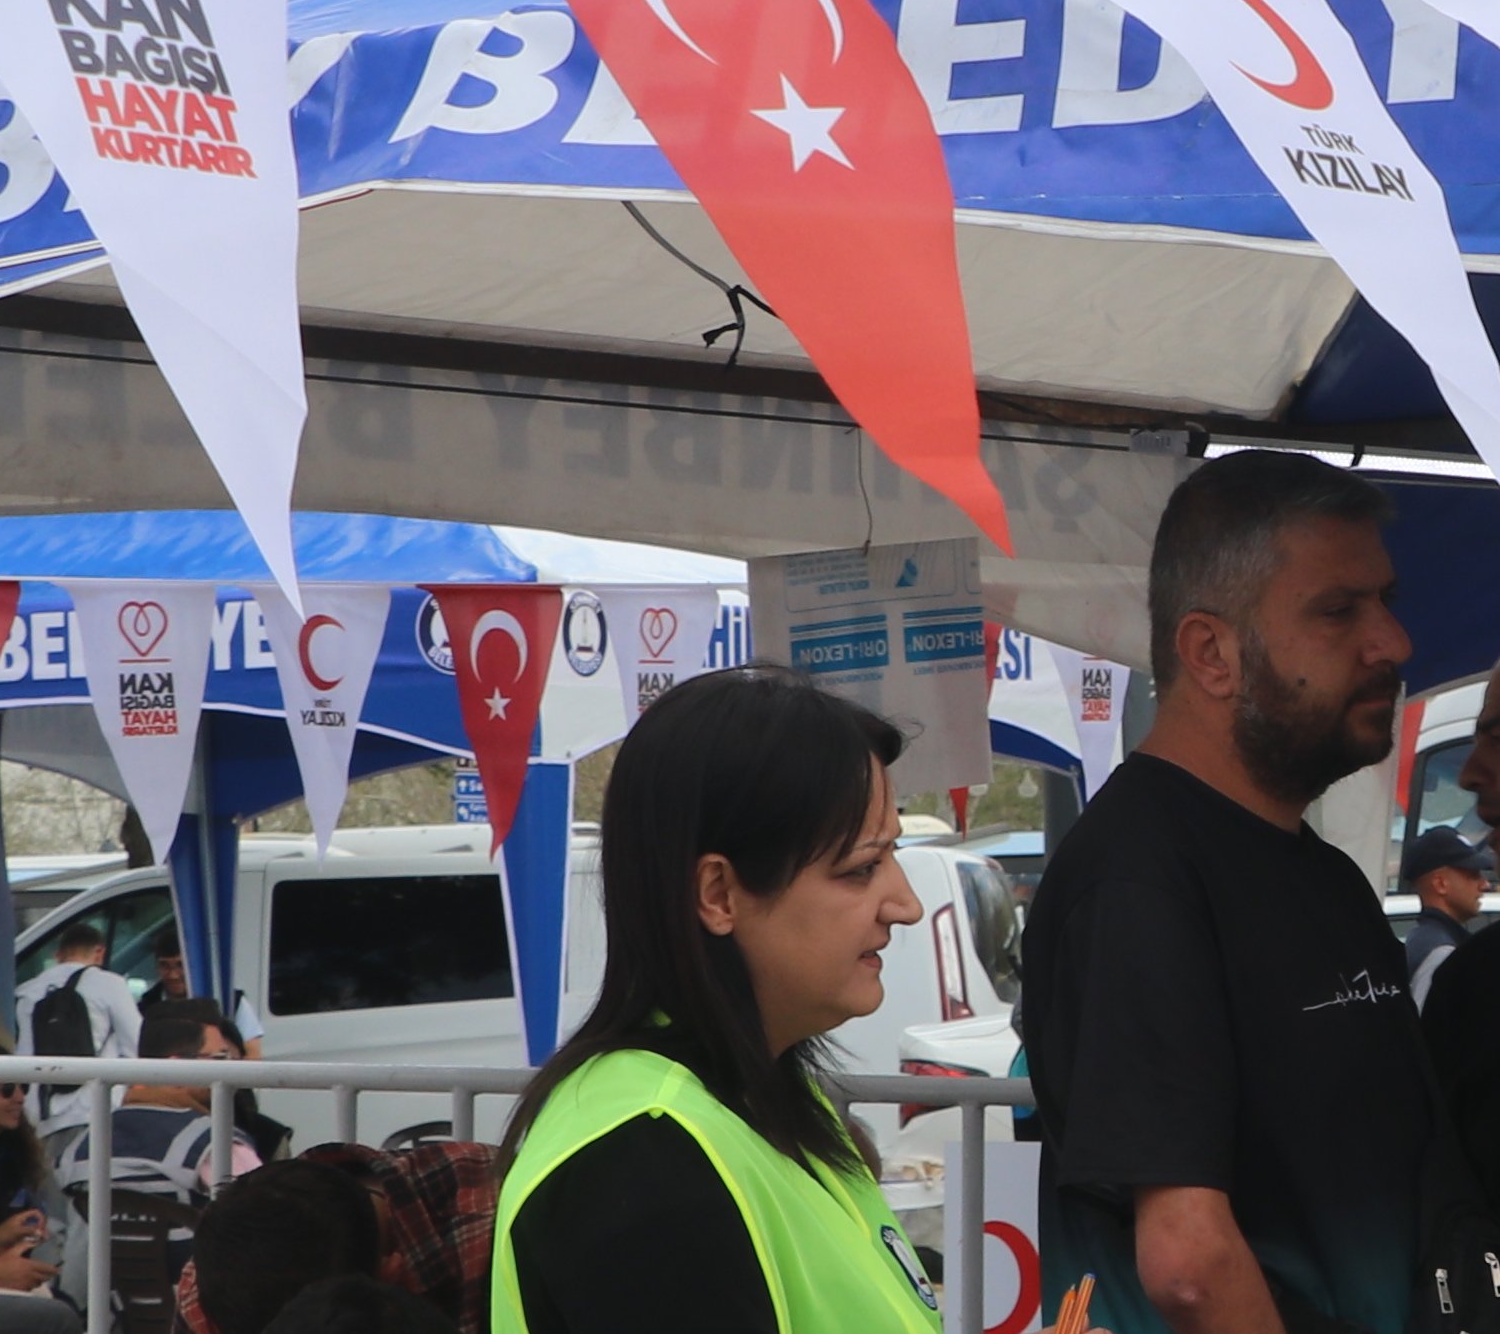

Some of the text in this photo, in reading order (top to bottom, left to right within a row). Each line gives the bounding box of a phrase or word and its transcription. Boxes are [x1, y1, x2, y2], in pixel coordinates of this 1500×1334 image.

[74, 76, 239, 143] HAYAT
[90, 125, 259, 179] KURTARIR
[1301, 124, 1365, 157] TÜRK
[1283, 147, 1415, 203] KIZILAY
